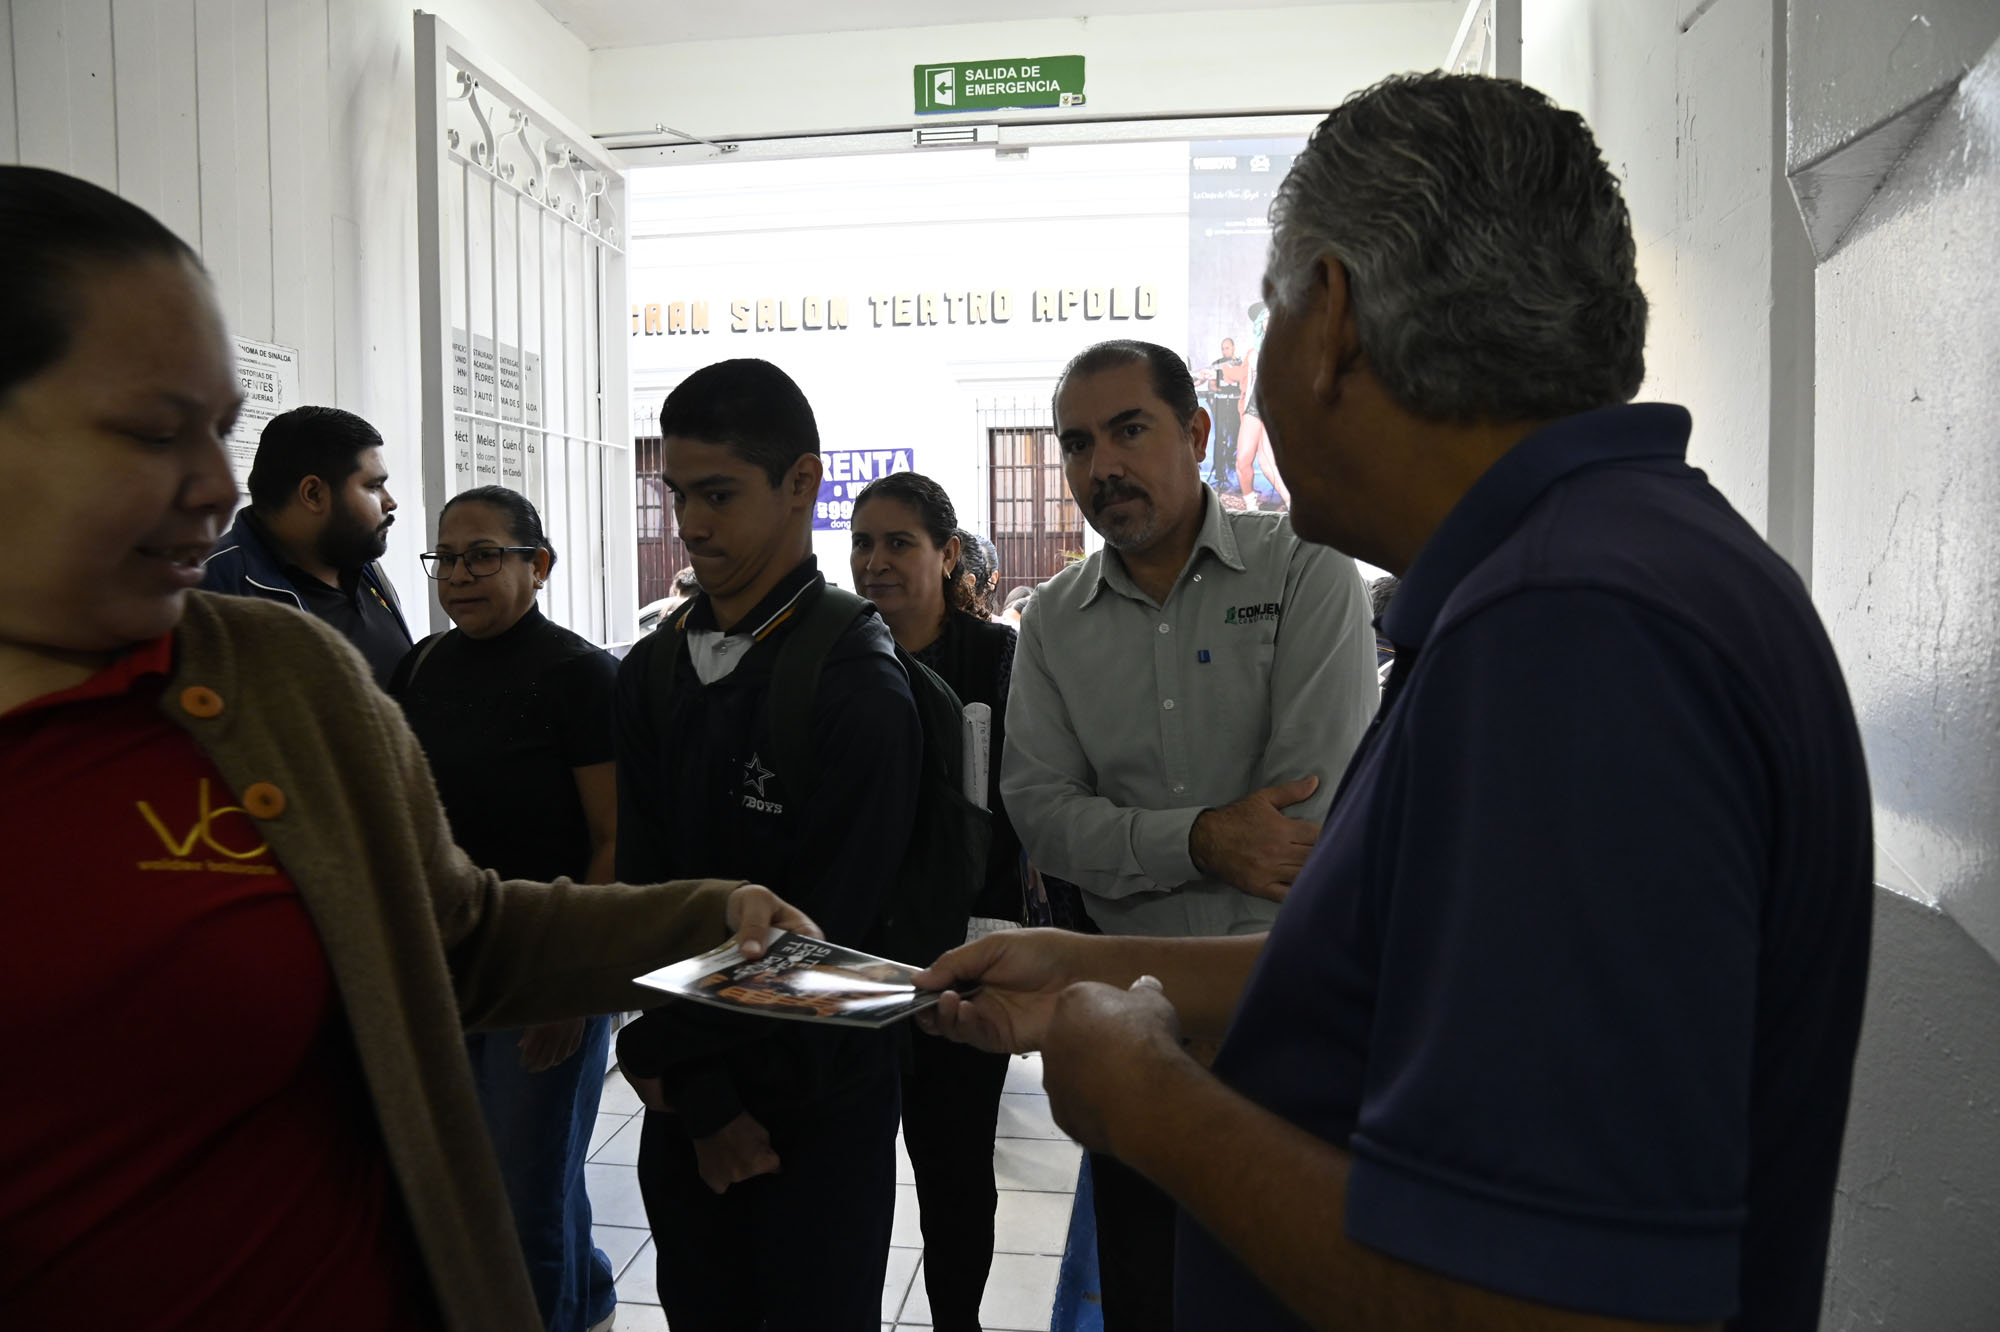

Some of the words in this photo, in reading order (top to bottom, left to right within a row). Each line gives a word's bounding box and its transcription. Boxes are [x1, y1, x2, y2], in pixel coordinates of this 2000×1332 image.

[965, 67, 1018, 81] SALIDA
[1021, 66, 1041, 78] DE
[965, 80, 1060, 96] EMERGENCIA
[731, 296, 849, 333] SALON
[868, 289, 1014, 328] TEATRO
[1032, 285, 1159, 322] APOLO
[260, 350, 267, 358] DE
[268, 352, 291, 362] SINALOA
[475, 372, 494, 385] FLORES
[500, 379, 514, 389] AGÓN
[503, 439, 517, 451] Cuén
[820, 450, 911, 481] RENTA
